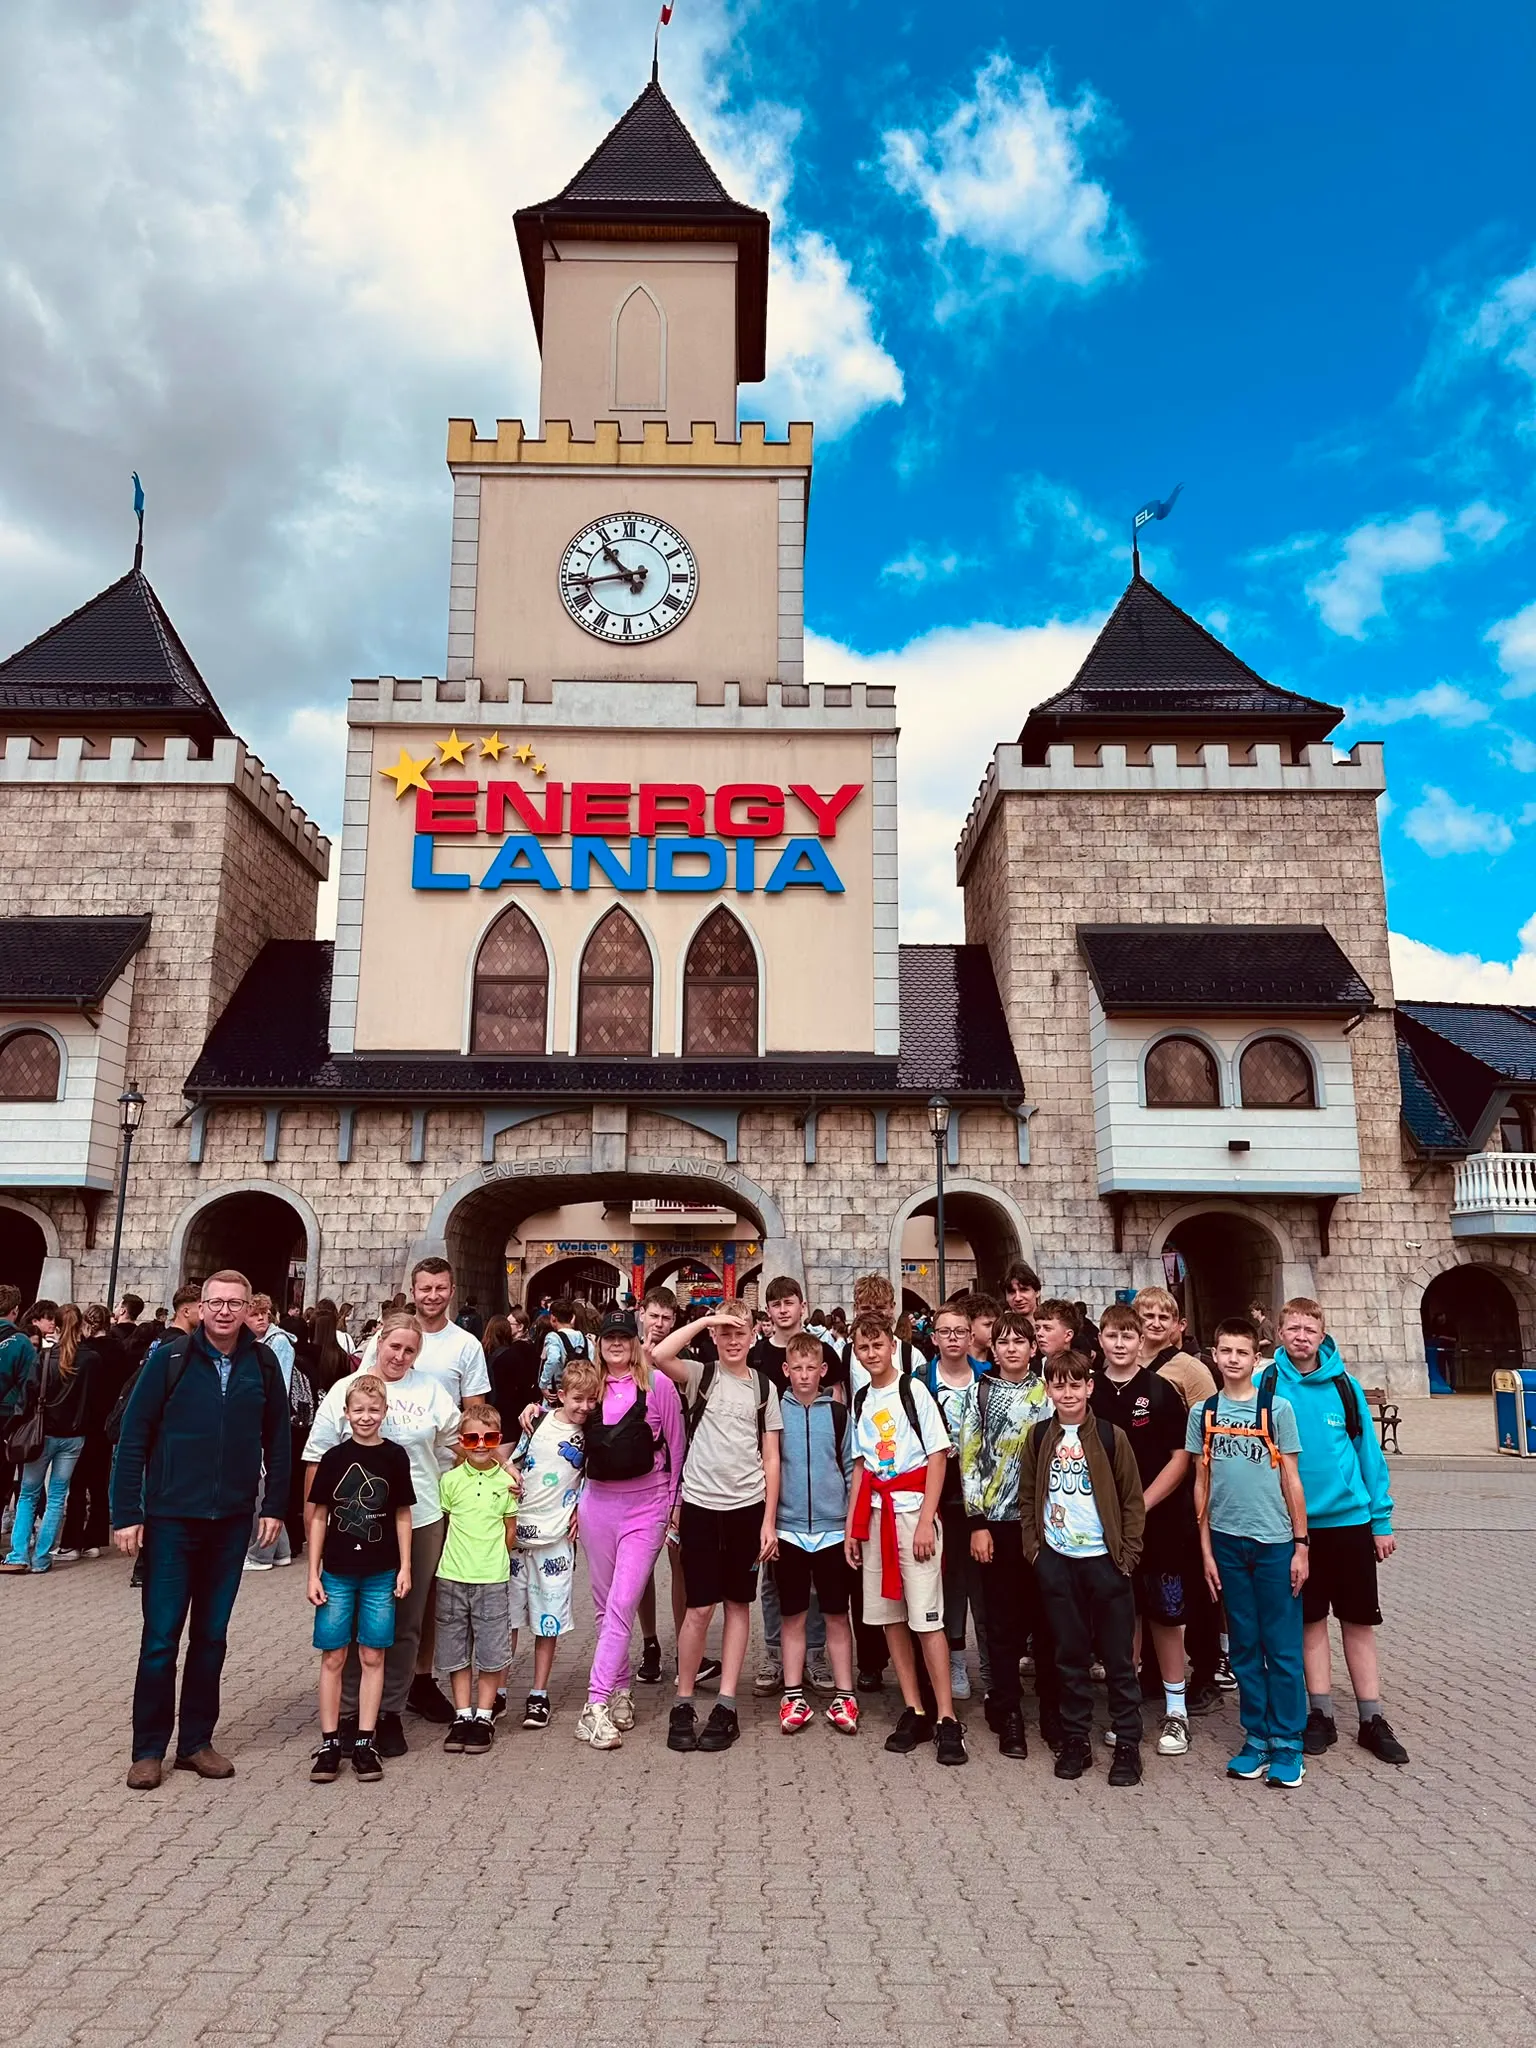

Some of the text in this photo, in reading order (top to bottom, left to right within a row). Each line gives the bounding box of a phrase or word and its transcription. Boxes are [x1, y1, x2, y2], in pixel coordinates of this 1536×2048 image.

[596, 527, 611, 542] XI
[622, 522, 636, 537] XII
[650, 529, 661, 543] I
[576, 547, 592, 559] X
[665, 548, 682, 560] II
[672, 573, 689, 583] III
[593, 610, 609, 629] VII
[622, 618, 632, 634] VI
[649, 613, 660, 628] V
[413, 780, 864, 838] ENERGY
[411, 834, 846, 893] LANDIA
[481, 1158, 740, 1190] ENERGY LANDIA
[1135, 1396, 1150, 1408] 95
[382, 1415, 411, 1426] LUB
